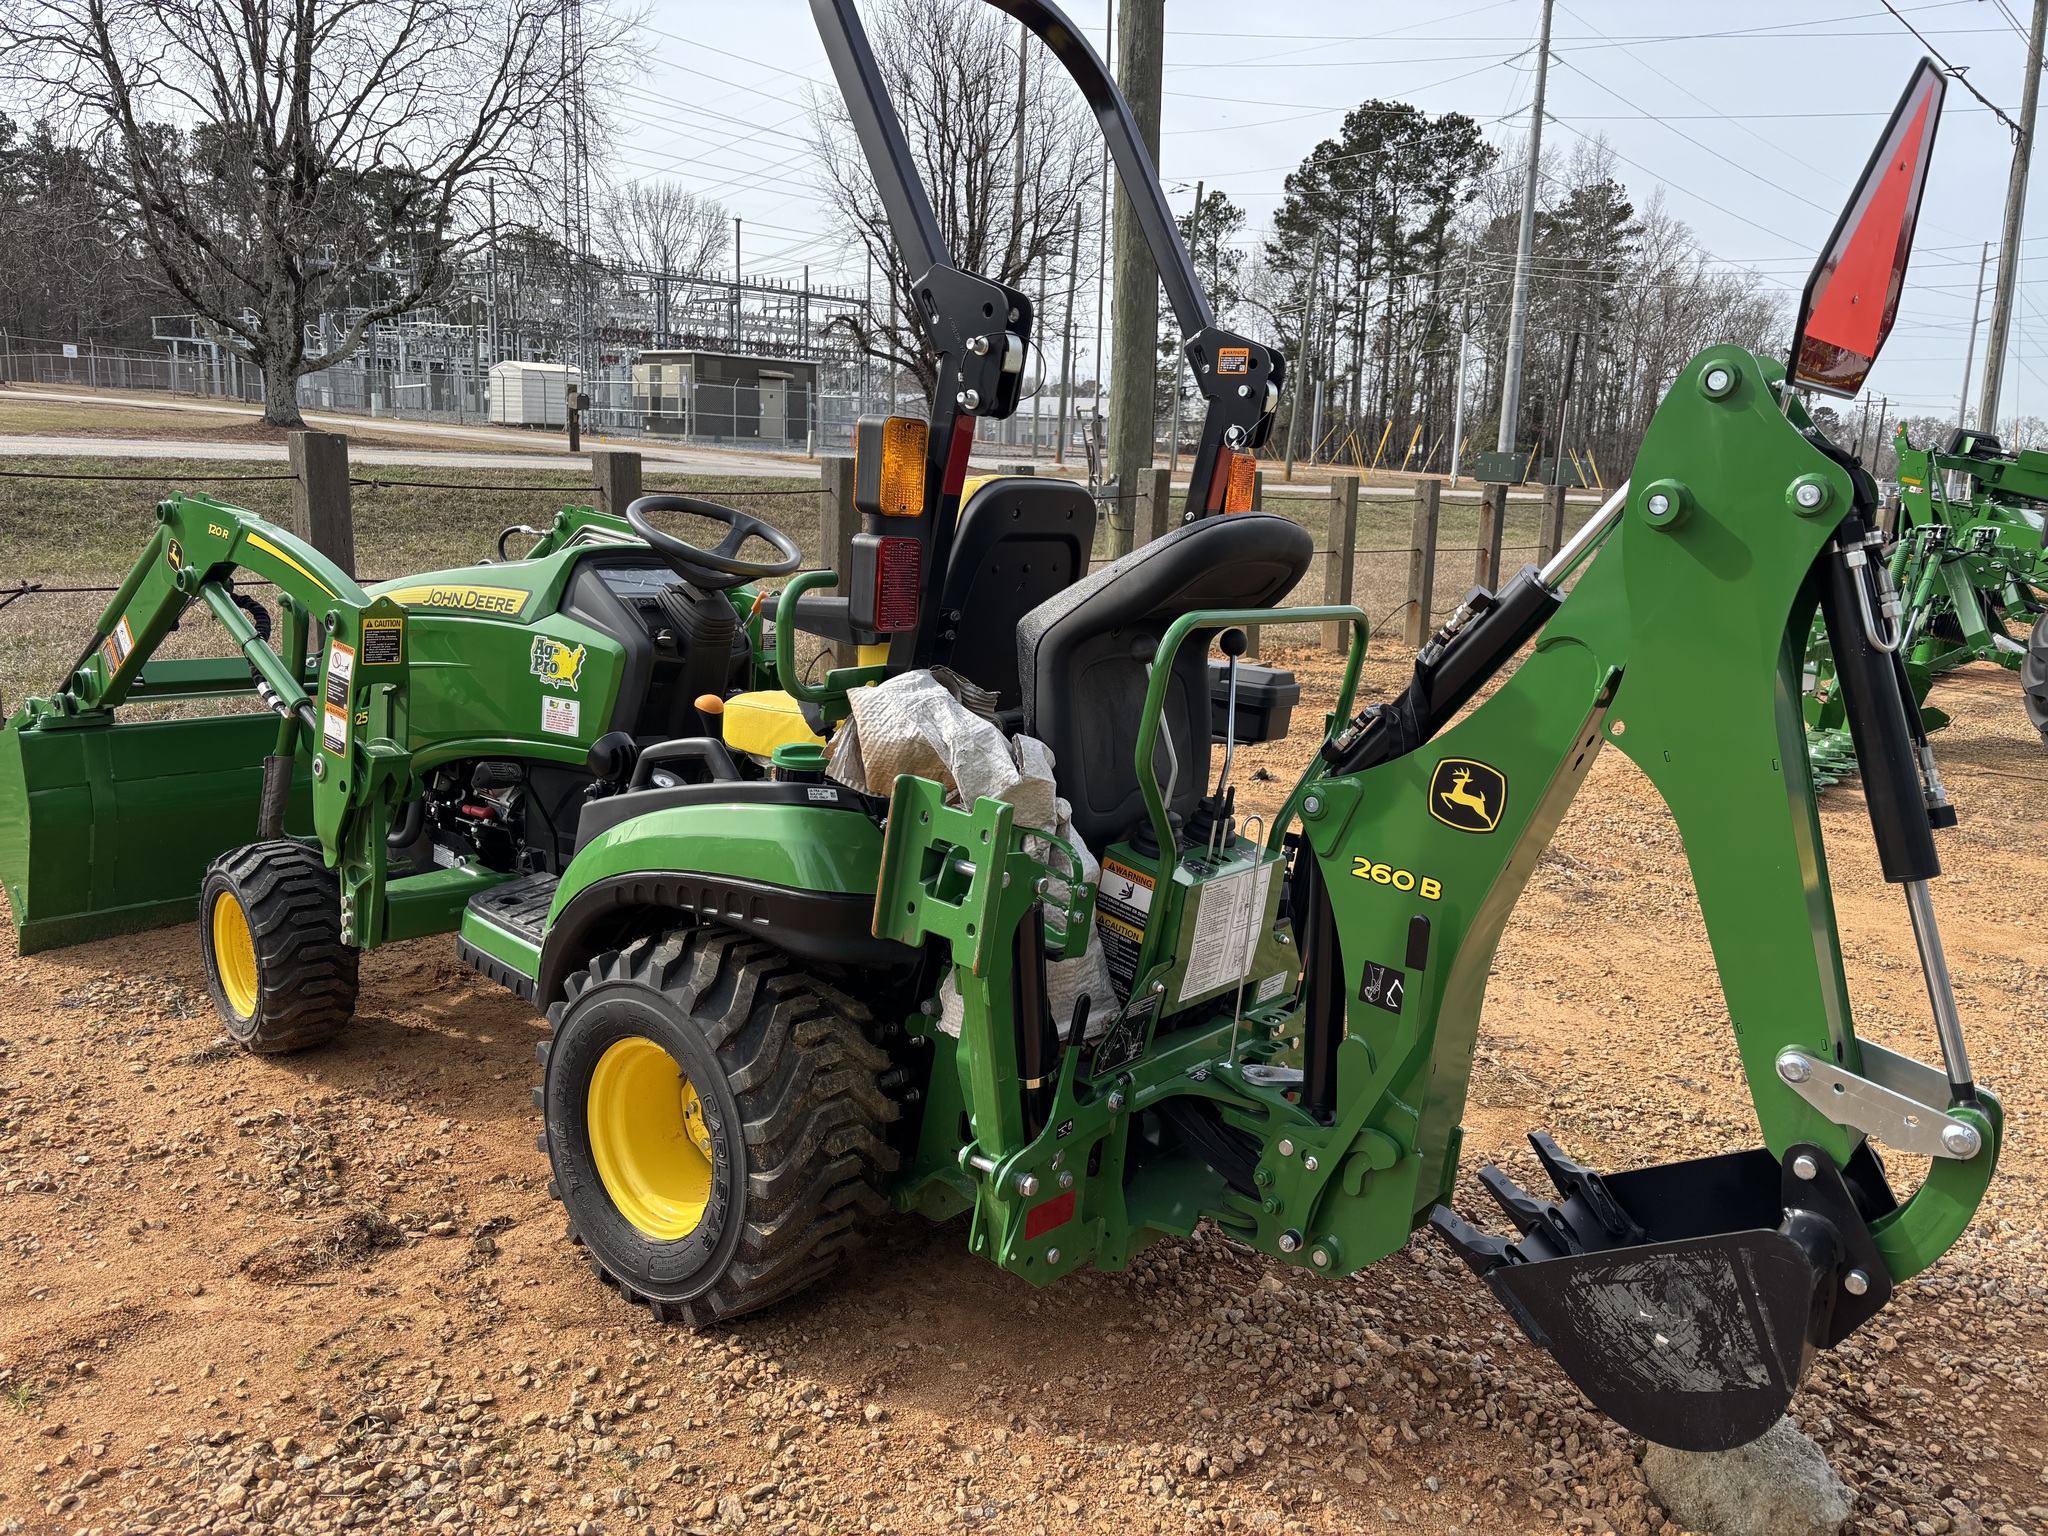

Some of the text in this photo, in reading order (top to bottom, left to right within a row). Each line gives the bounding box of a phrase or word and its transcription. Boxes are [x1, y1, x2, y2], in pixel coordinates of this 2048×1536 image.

[208, 523, 230, 540] 120 R
[423, 588, 517, 612] JOHN DEERE
[374, 619, 401, 628] CAUTION
[532, 655, 558, 674] Pro
[1115, 865, 1153, 888] WARNING
[1350, 855, 1443, 902] 260 B
[1105, 918, 1140, 941] CAUTION
[556, 1038, 578, 1106] CHIEF
[703, 1092, 729, 1252] CARLSTAR
